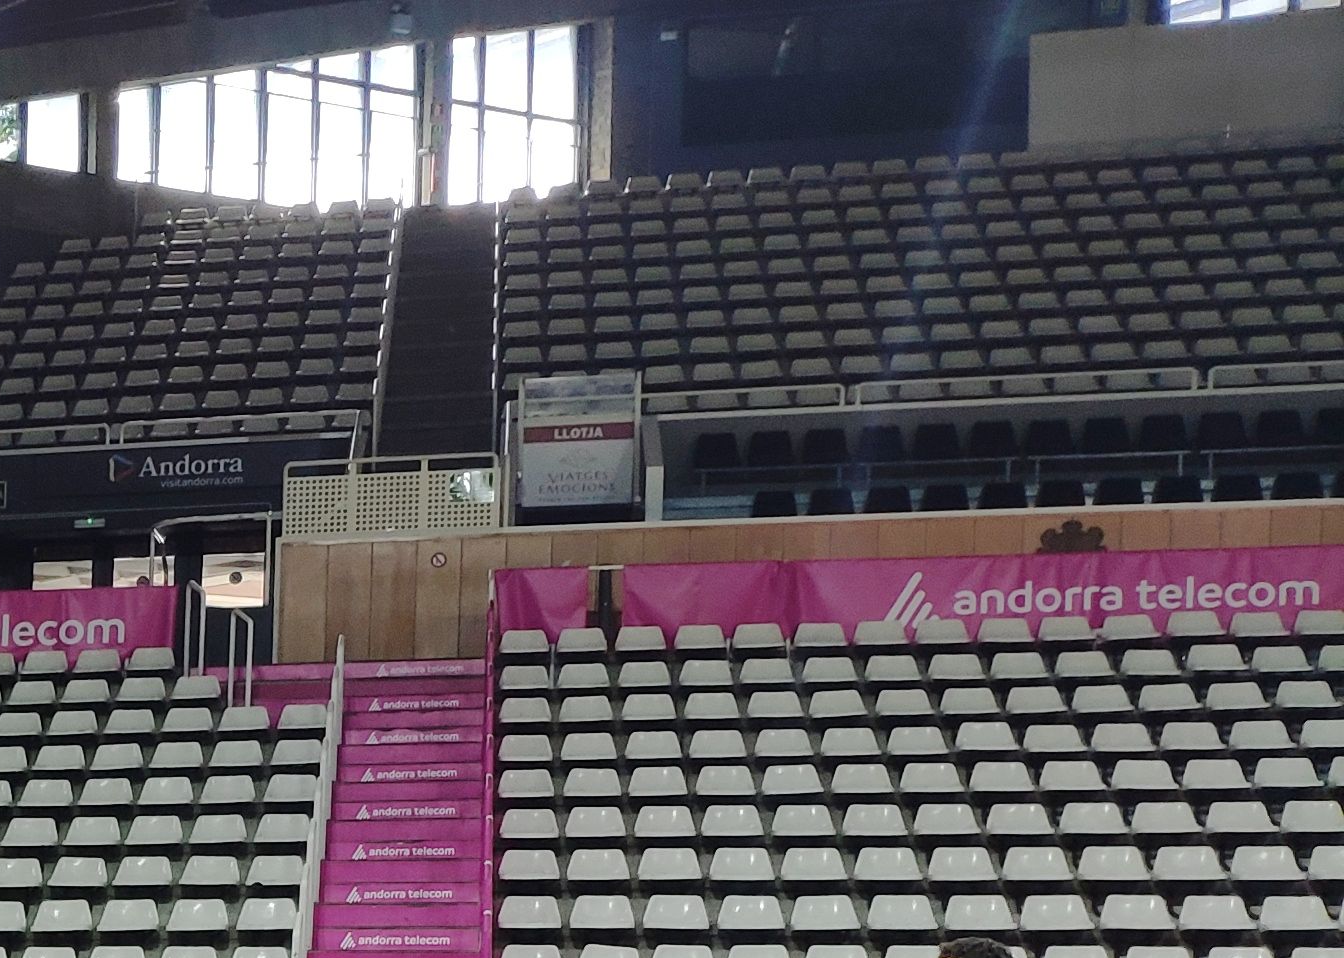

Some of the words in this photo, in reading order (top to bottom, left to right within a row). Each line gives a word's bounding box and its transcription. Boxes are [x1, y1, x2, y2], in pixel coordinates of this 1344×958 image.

[553, 426, 604, 440] LLOTJA
[138, 454, 243, 478] Andorra
[160, 475, 244, 488] visitandorra.com
[952, 580, 1123, 616] andorra
[1136, 576, 1320, 609] telecom
[383, 700, 419, 710] andorra
[422, 699, 459, 709] telecom
[381, 732, 418, 743] andorra
[420, 732, 459, 742] telecom
[377, 769, 415, 780] andorra
[418, 768, 457, 779] telecom
[372, 806, 412, 817] andorra
[415, 805, 456, 816] telecom
[369, 845, 410, 857] andorra
[412, 845, 455, 857] telecom
[364, 888, 406, 900] andorra
[409, 887, 452, 899] telecom
[358, 935, 402, 947] andorra
[404, 934, 450, 946] telecom
